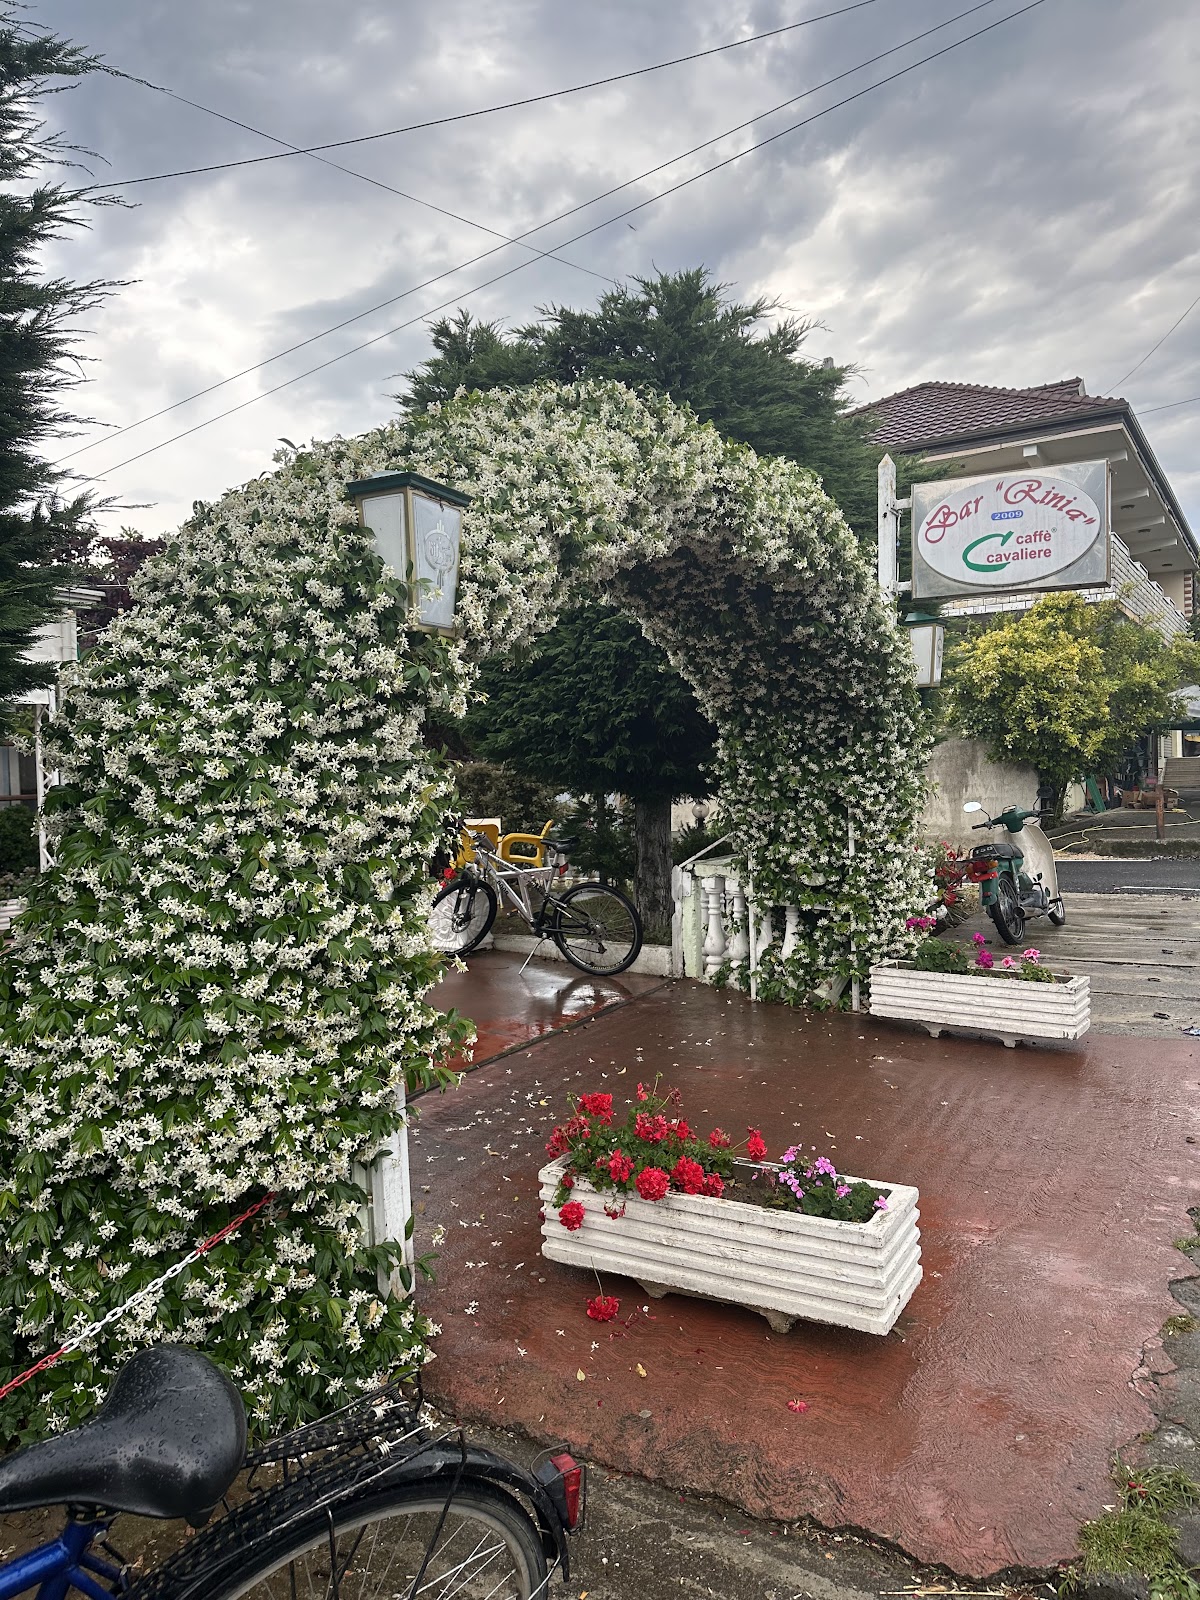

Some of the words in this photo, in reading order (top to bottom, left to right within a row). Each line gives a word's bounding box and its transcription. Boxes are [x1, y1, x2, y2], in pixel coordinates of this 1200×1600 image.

[925, 496, 984, 544] Bar
[994, 511, 1022, 520] 2009
[1016, 530, 1052, 544] caffè
[986, 547, 1052, 563] cavaliere
